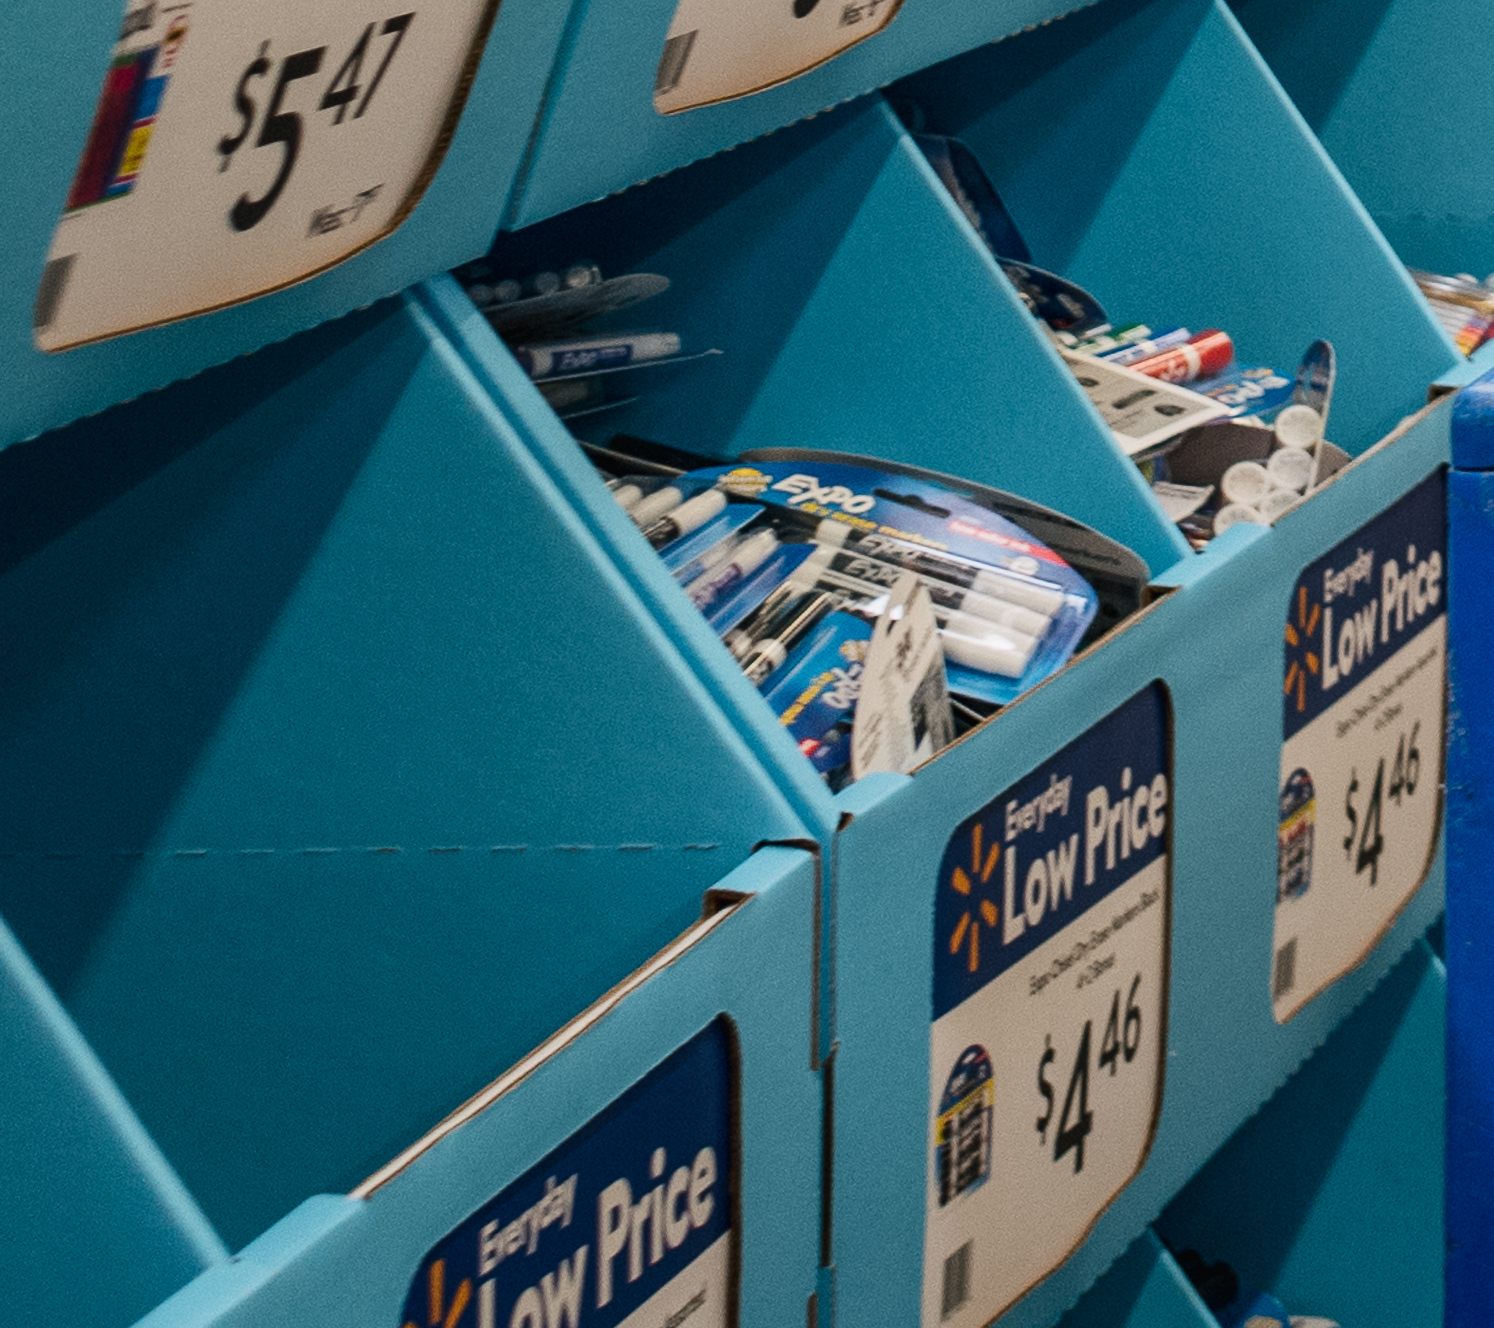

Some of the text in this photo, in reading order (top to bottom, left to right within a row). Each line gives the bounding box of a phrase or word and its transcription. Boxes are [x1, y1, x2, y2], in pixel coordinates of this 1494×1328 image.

[772, 472, 877, 515] EXPO
[1321, 595, 1378, 692] Low
[1380, 542, 1443, 645] Price
[1322, 547, 1376, 604] Everyday
[1002, 833, 1081, 946] Low
[1084, 766, 1169, 886] Price
[1004, 772, 1073, 843] Everyday
[476, 1173, 579, 1278] Everyday
[595, 1145, 719, 1311] Price
